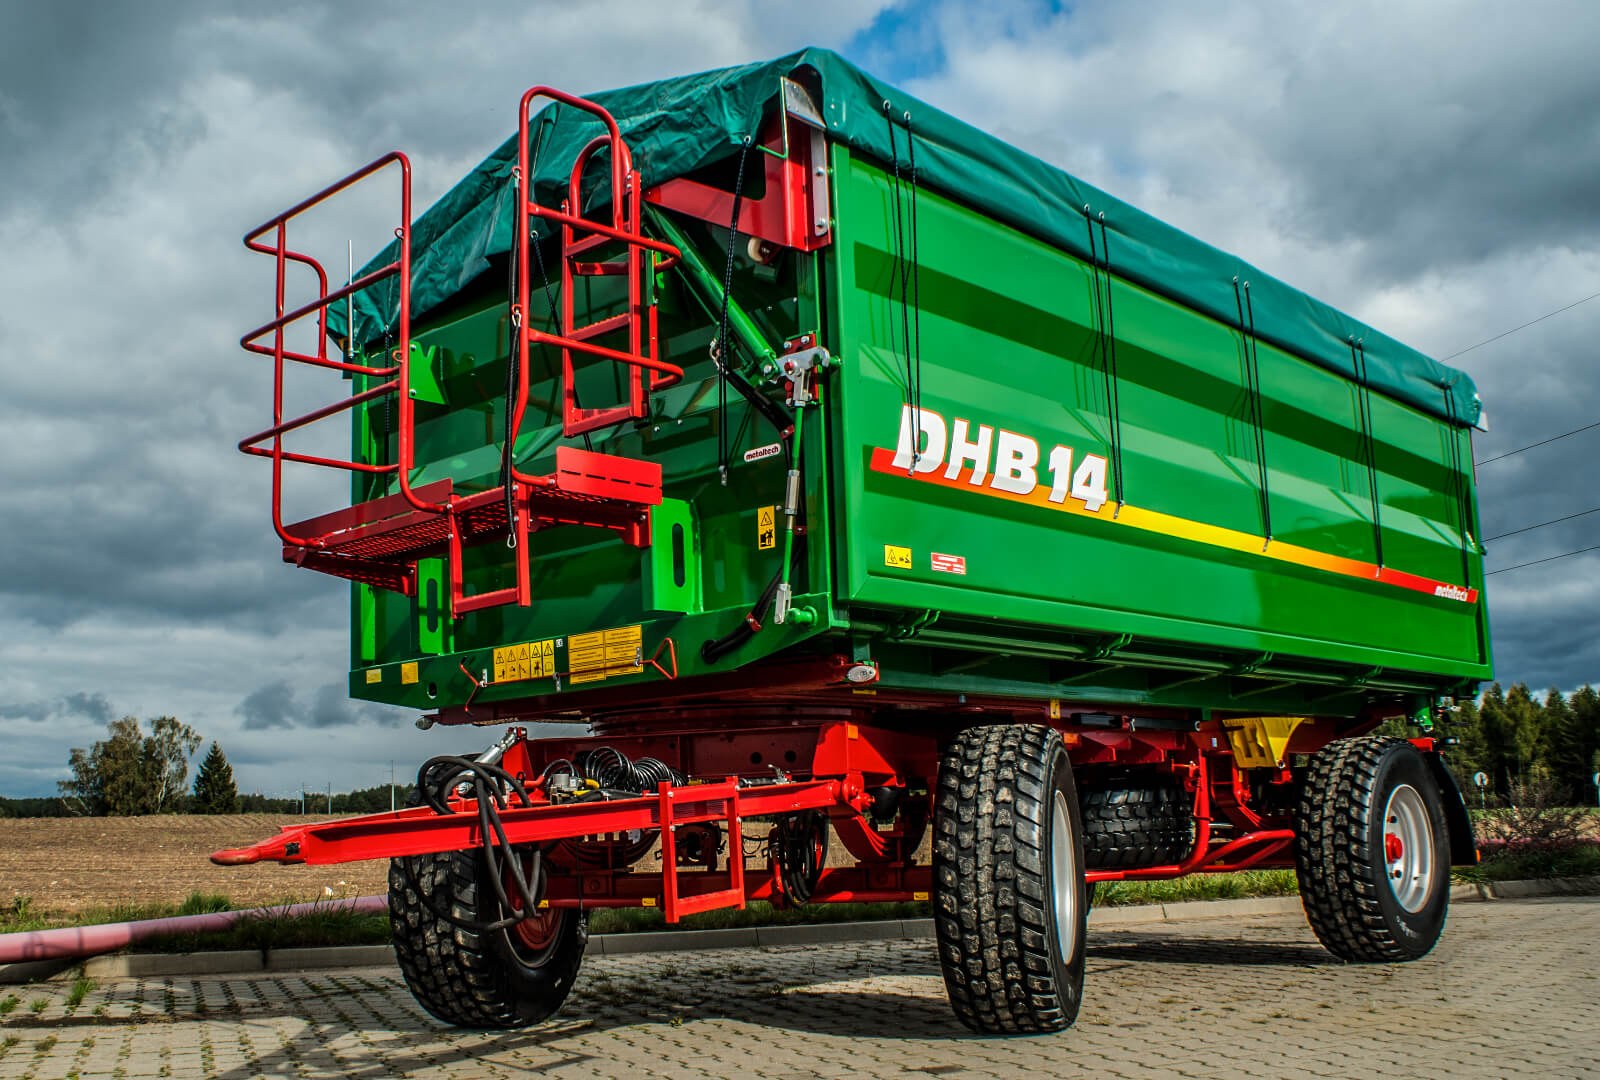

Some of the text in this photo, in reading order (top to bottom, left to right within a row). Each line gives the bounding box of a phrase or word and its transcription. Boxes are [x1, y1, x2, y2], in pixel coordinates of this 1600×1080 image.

[745, 445, 779, 461] metaltech
[891, 403, 1108, 513] DHB 14
